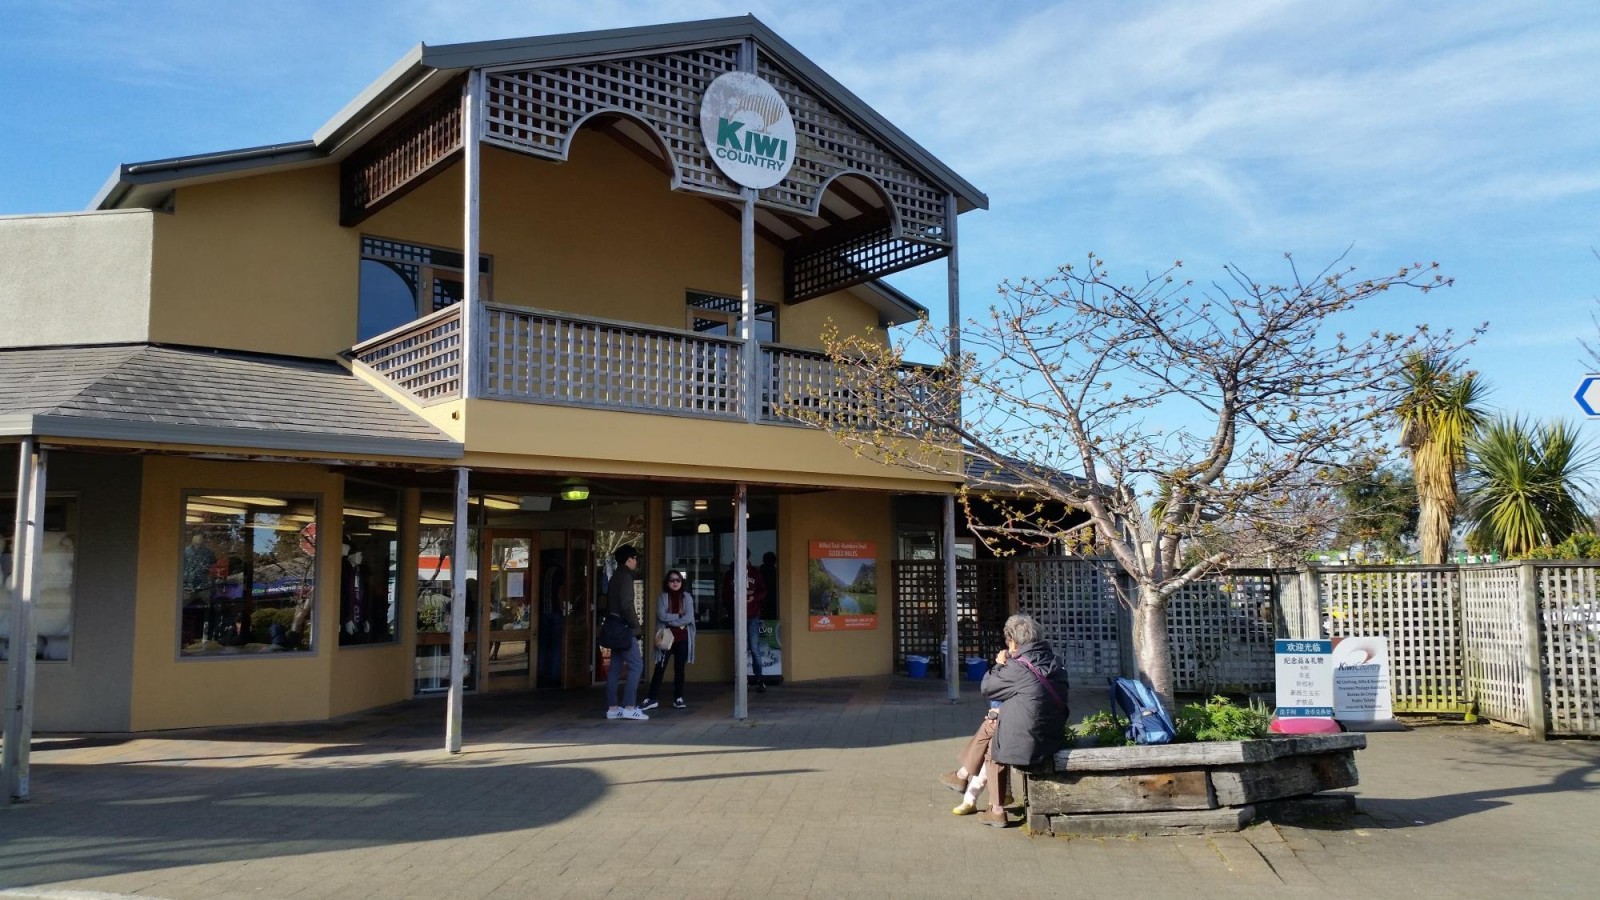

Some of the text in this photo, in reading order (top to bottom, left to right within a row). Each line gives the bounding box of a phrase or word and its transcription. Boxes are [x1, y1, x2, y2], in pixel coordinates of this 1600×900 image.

[717, 117, 788, 161] KIWI
[716, 148, 785, 171] COUNTRY
[1287, 643, 1321, 652] 欢迎光临
